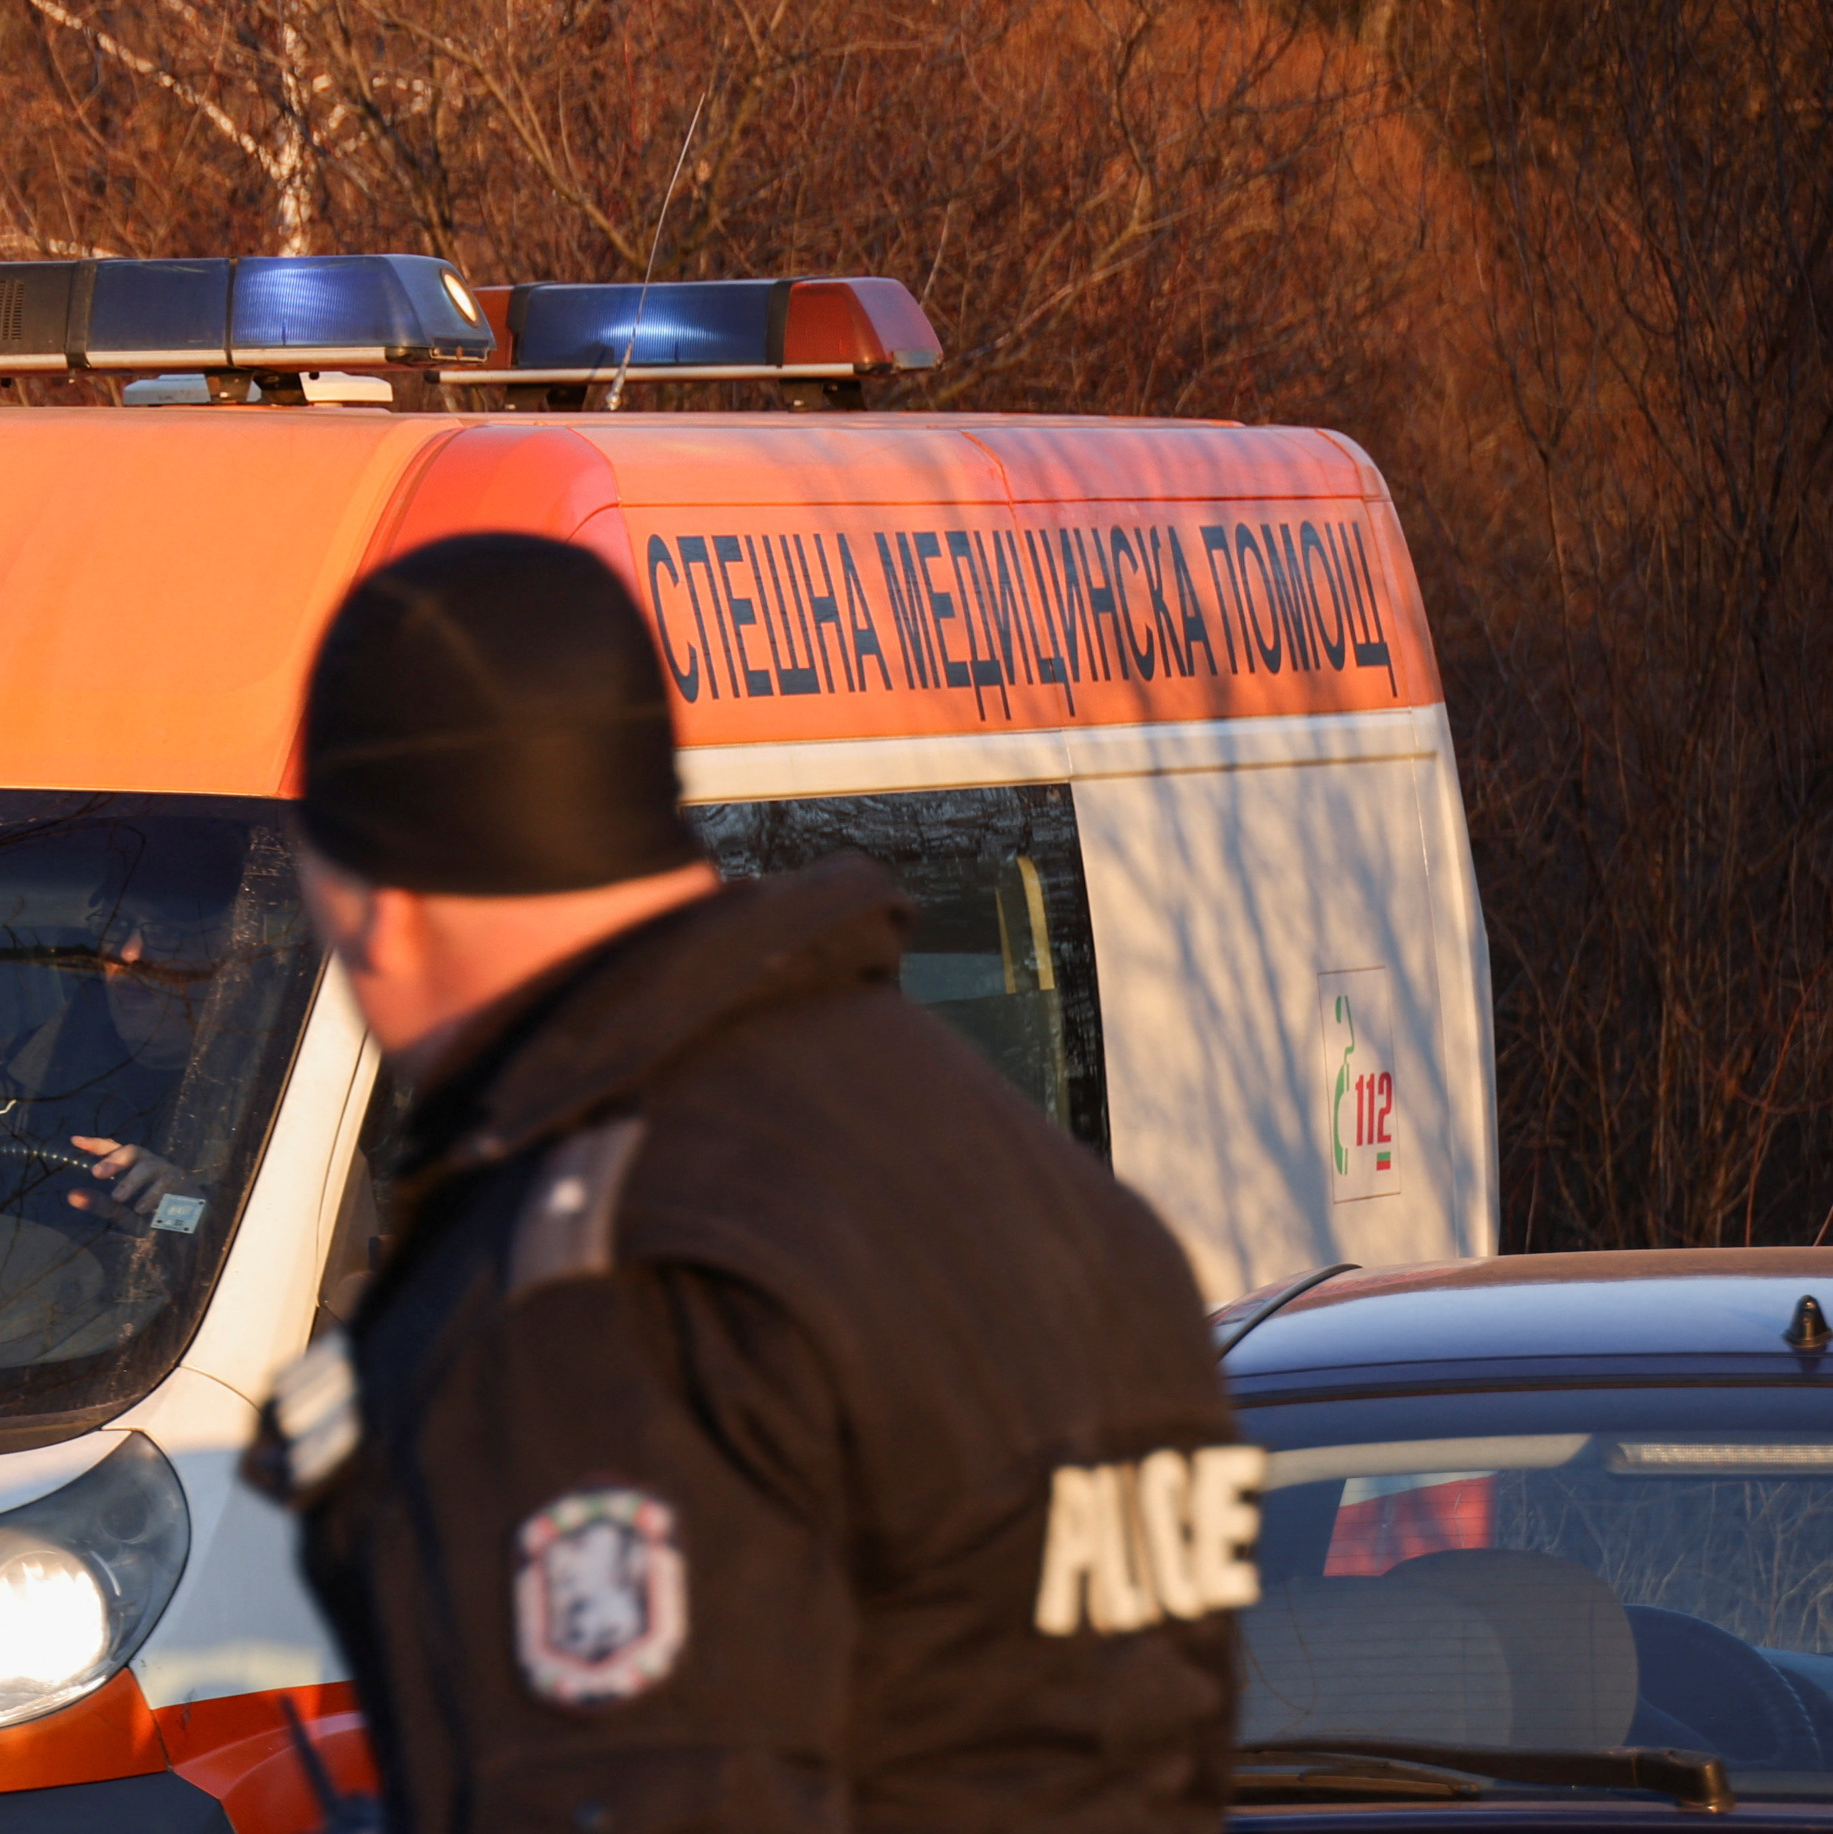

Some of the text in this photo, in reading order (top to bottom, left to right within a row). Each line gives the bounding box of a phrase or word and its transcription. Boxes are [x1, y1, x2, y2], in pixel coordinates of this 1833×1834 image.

[647, 520, 1398, 722] СПЕШНА МЕДИЦИНСКА ПОМОЩ
[1355, 1071, 1393, 1147] 112
